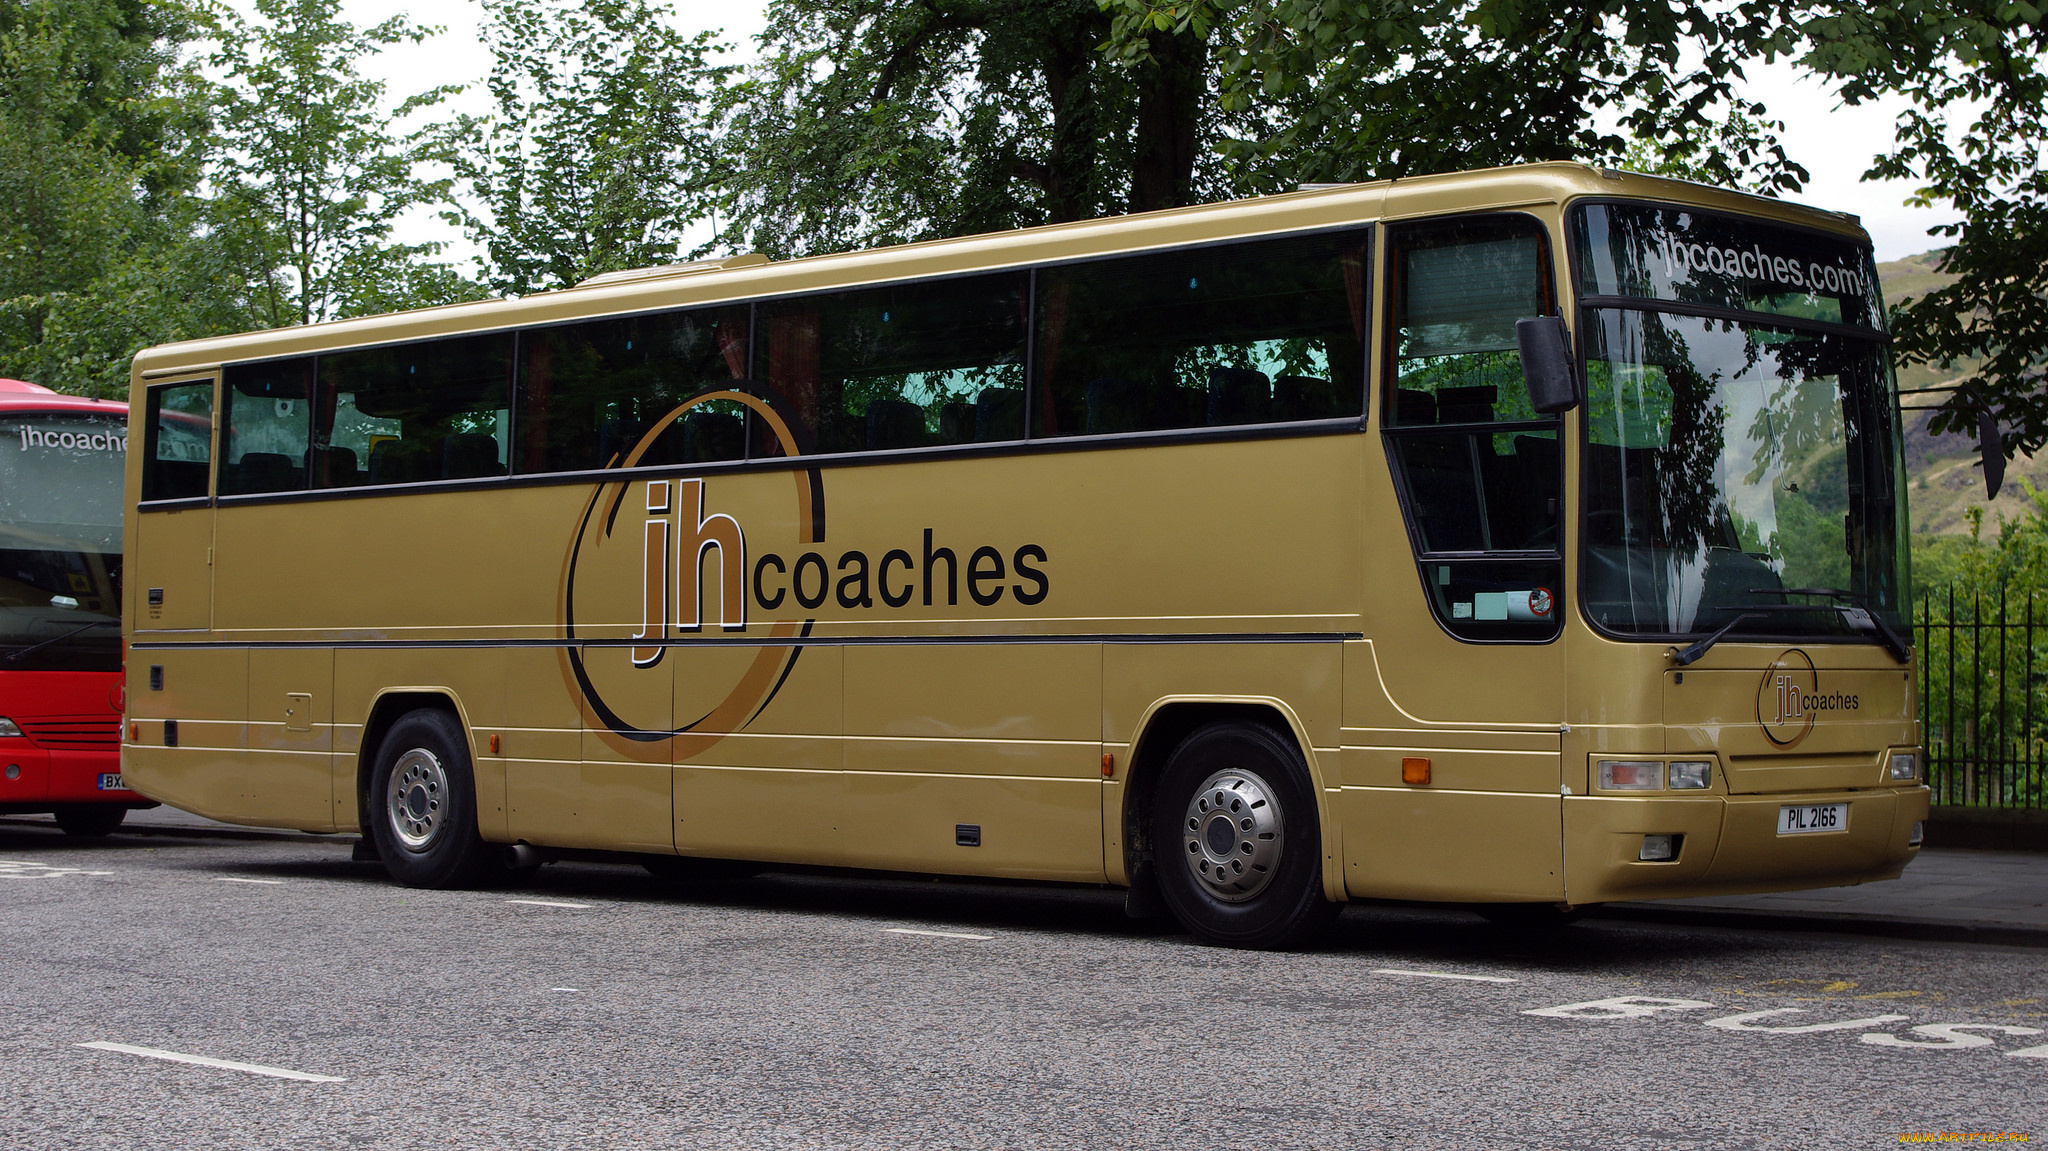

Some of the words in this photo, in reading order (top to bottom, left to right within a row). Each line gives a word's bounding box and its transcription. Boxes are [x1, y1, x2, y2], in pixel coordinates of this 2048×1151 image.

[1662, 231, 1863, 297] jhcoaches.com
[1787, 808, 1807, 829] PIL
[1810, 807, 1837, 828] 2166
[1521, 995, 2046, 1050] BUS
